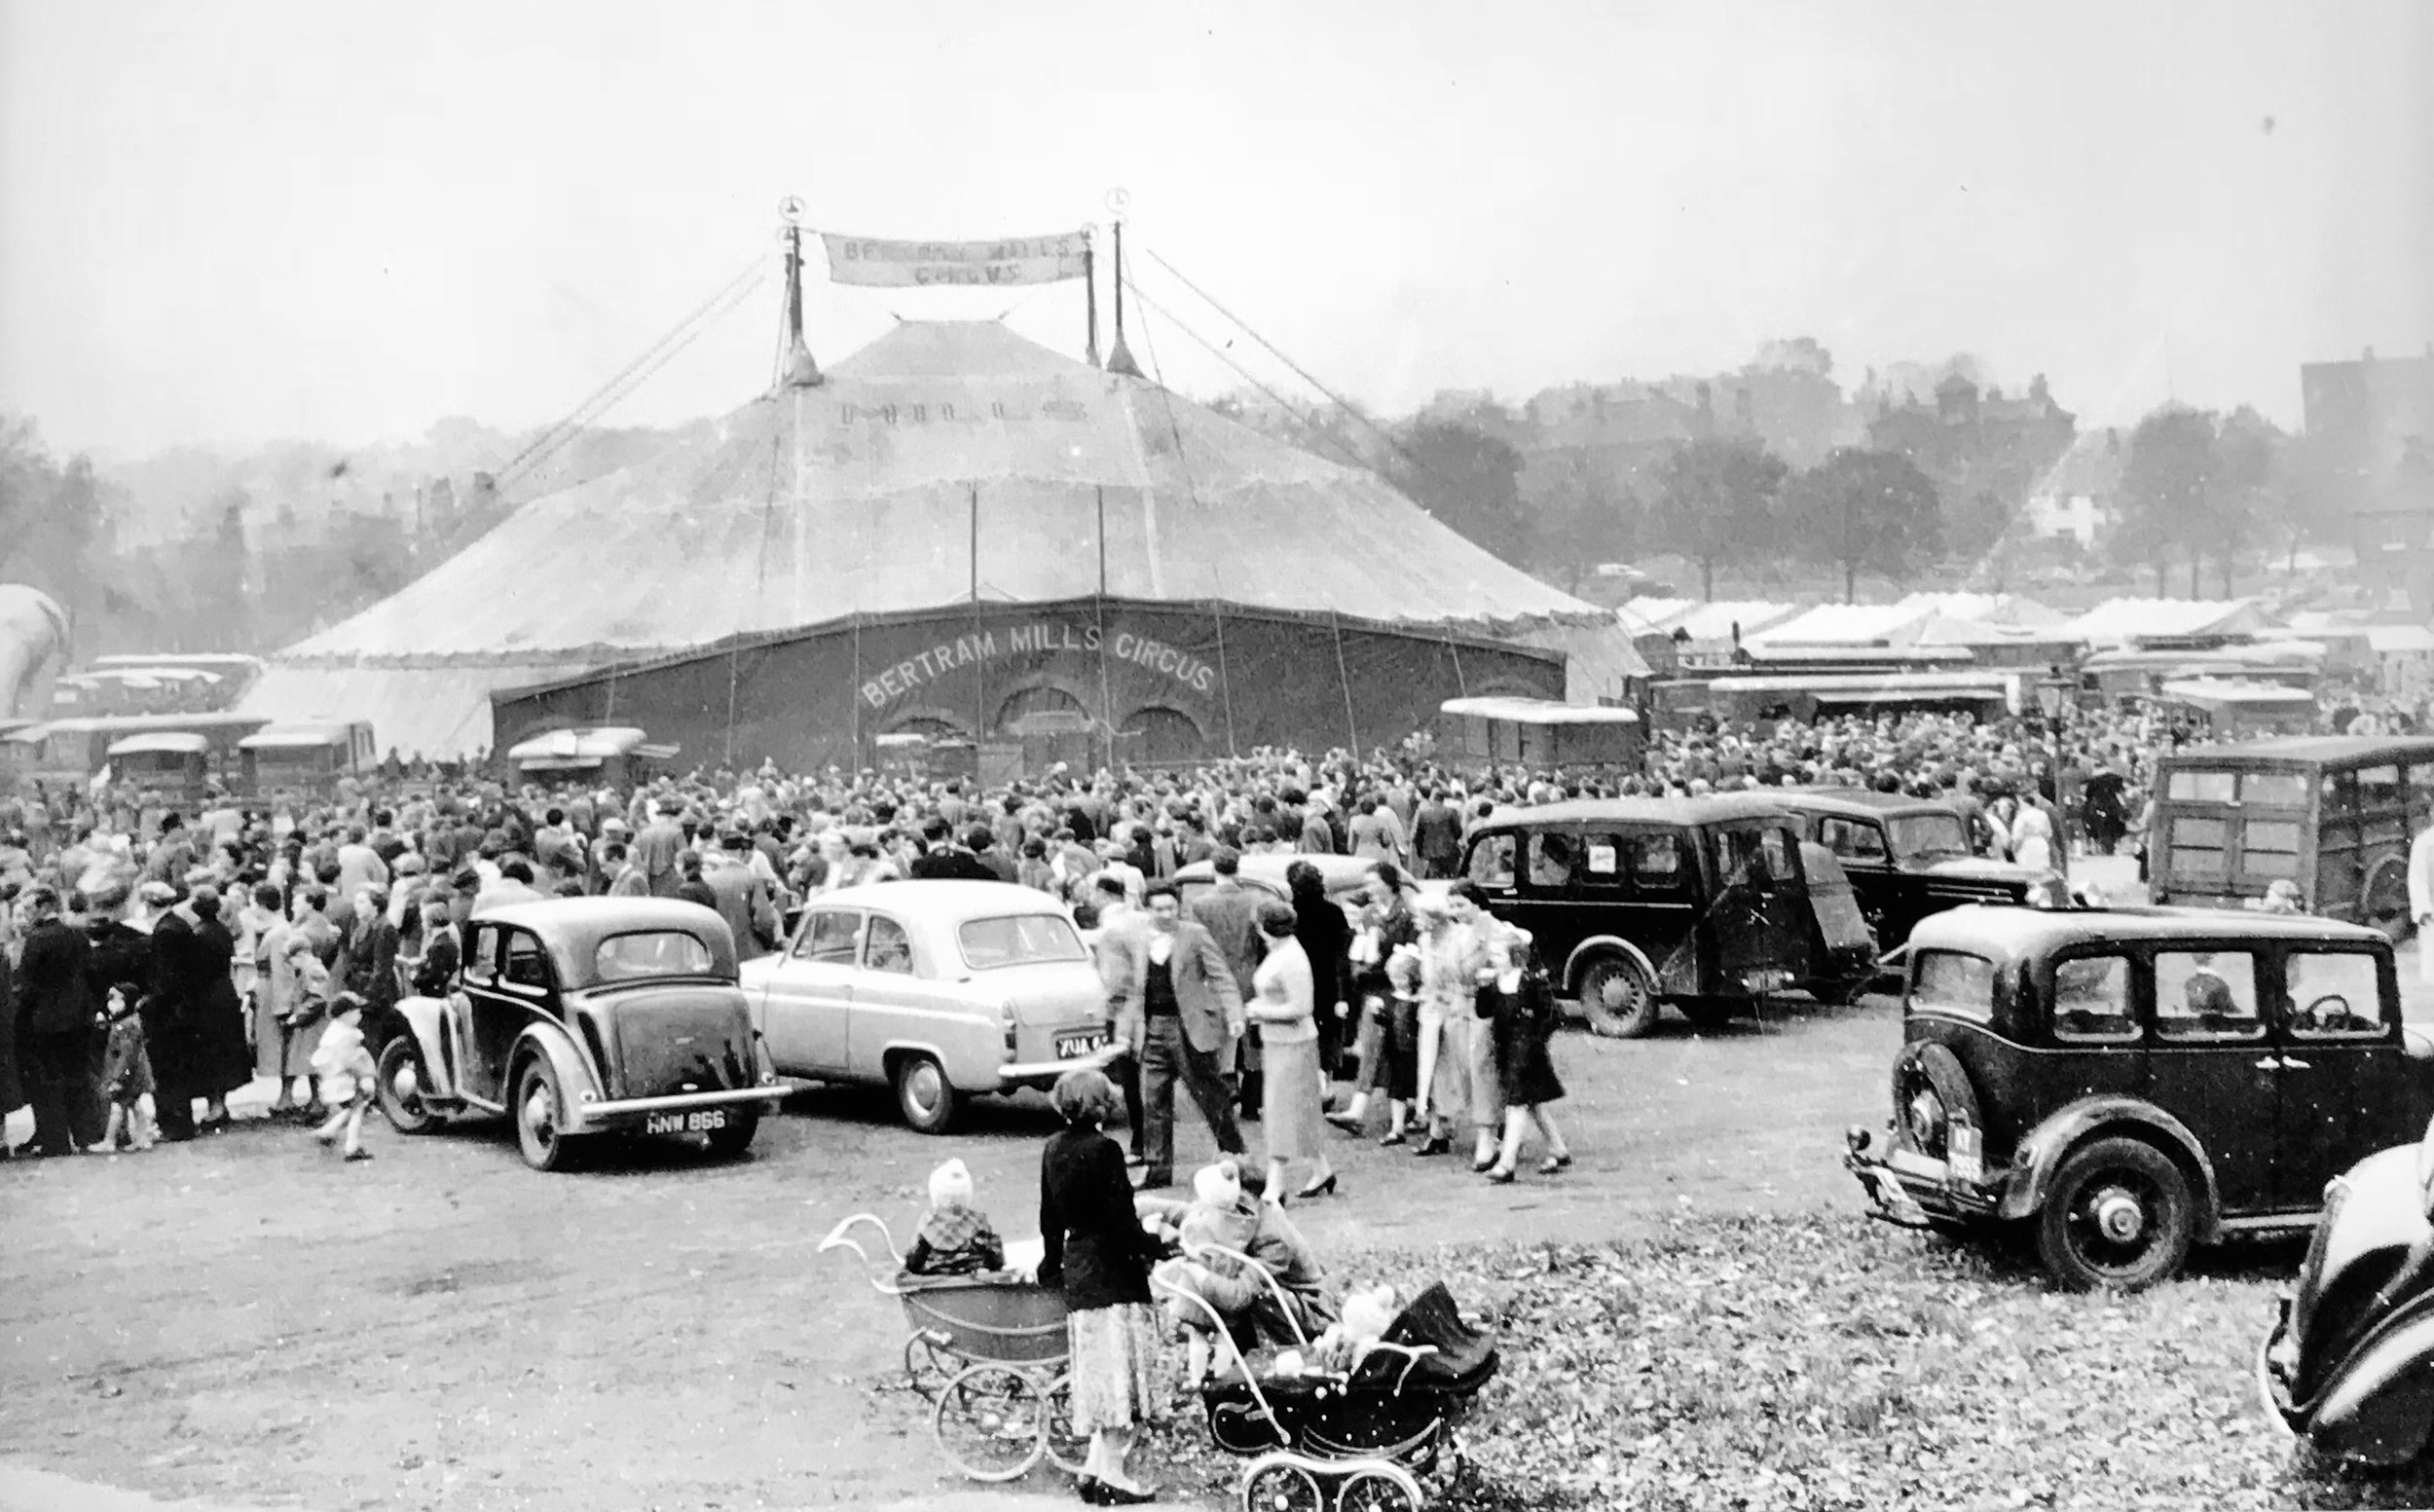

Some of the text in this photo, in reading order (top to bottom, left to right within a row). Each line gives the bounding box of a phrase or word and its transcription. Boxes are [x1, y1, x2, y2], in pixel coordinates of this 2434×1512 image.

[861, 623, 1216, 708] BERTRAM MILLS CIRCUS
